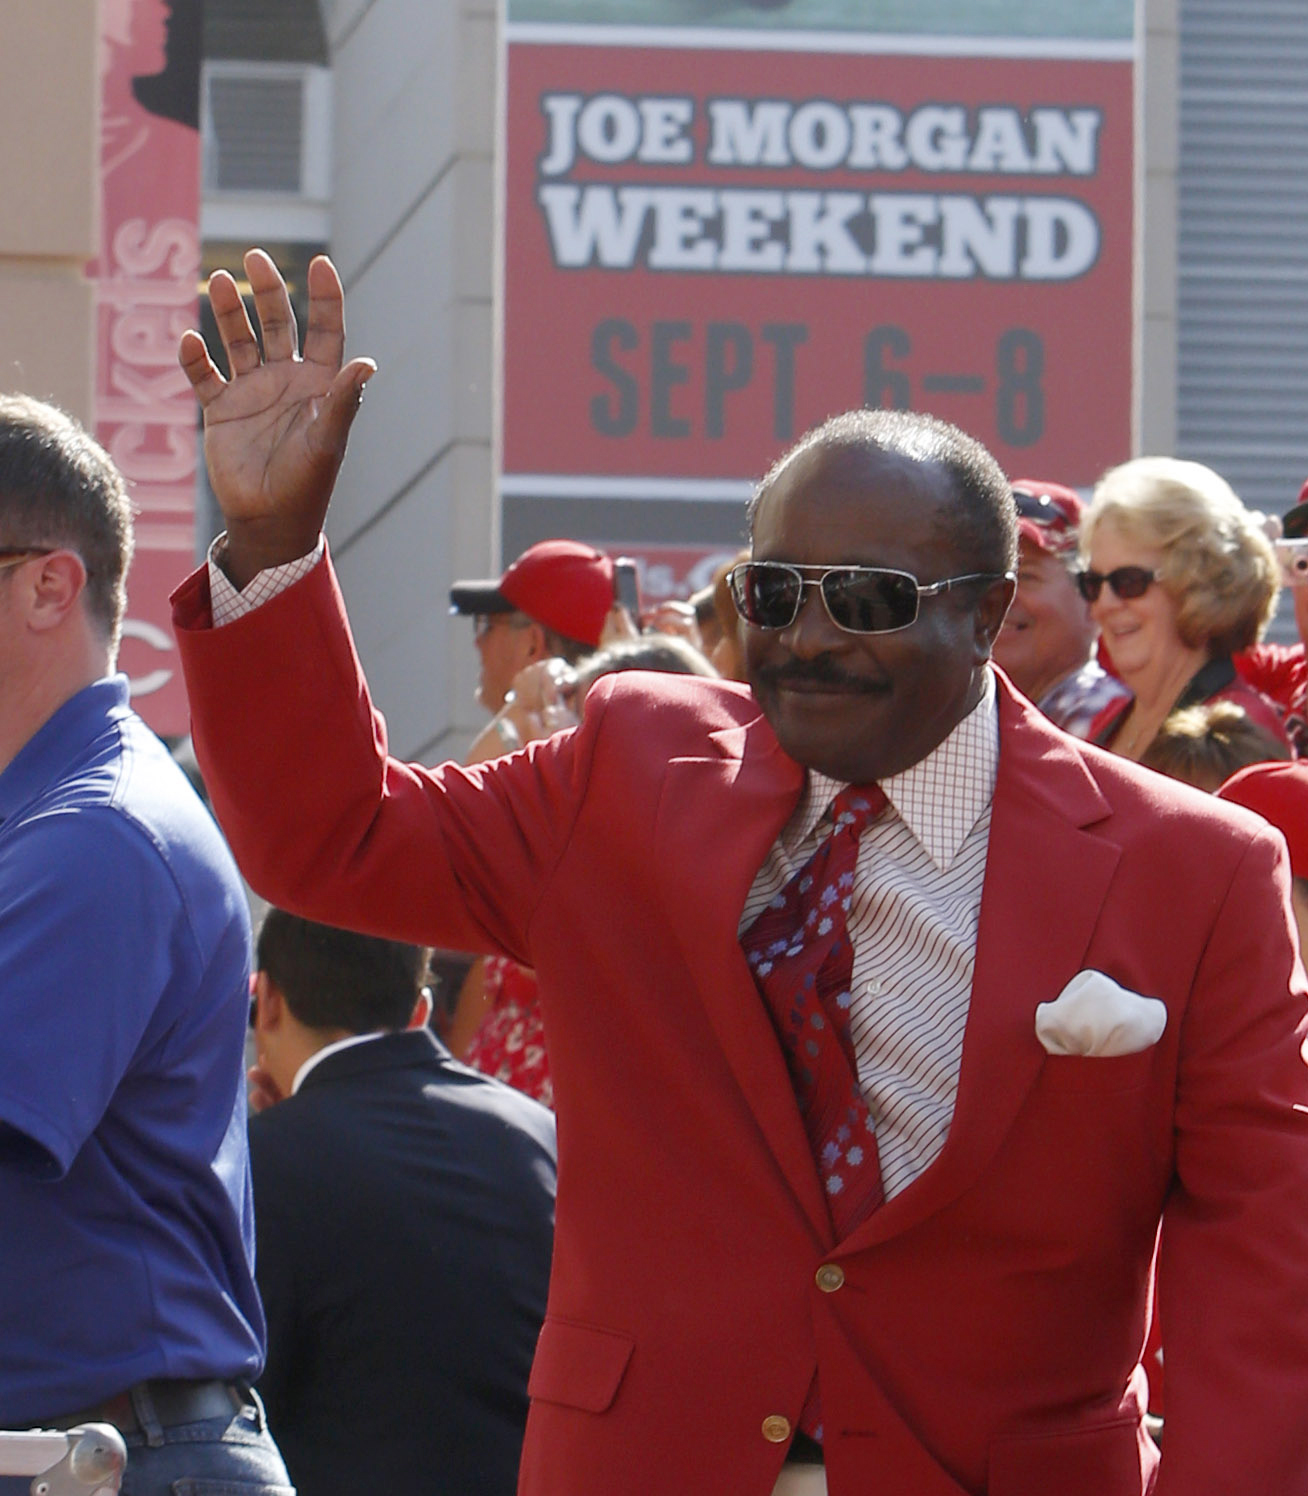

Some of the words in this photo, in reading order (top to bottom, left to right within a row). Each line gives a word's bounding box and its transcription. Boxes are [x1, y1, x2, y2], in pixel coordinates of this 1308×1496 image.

[540, 91, 694, 178] JOE
[707, 98, 1101, 177] MORGAN
[537, 183, 1102, 282] WEEKEND
[589, 318, 824, 442] SEPT
